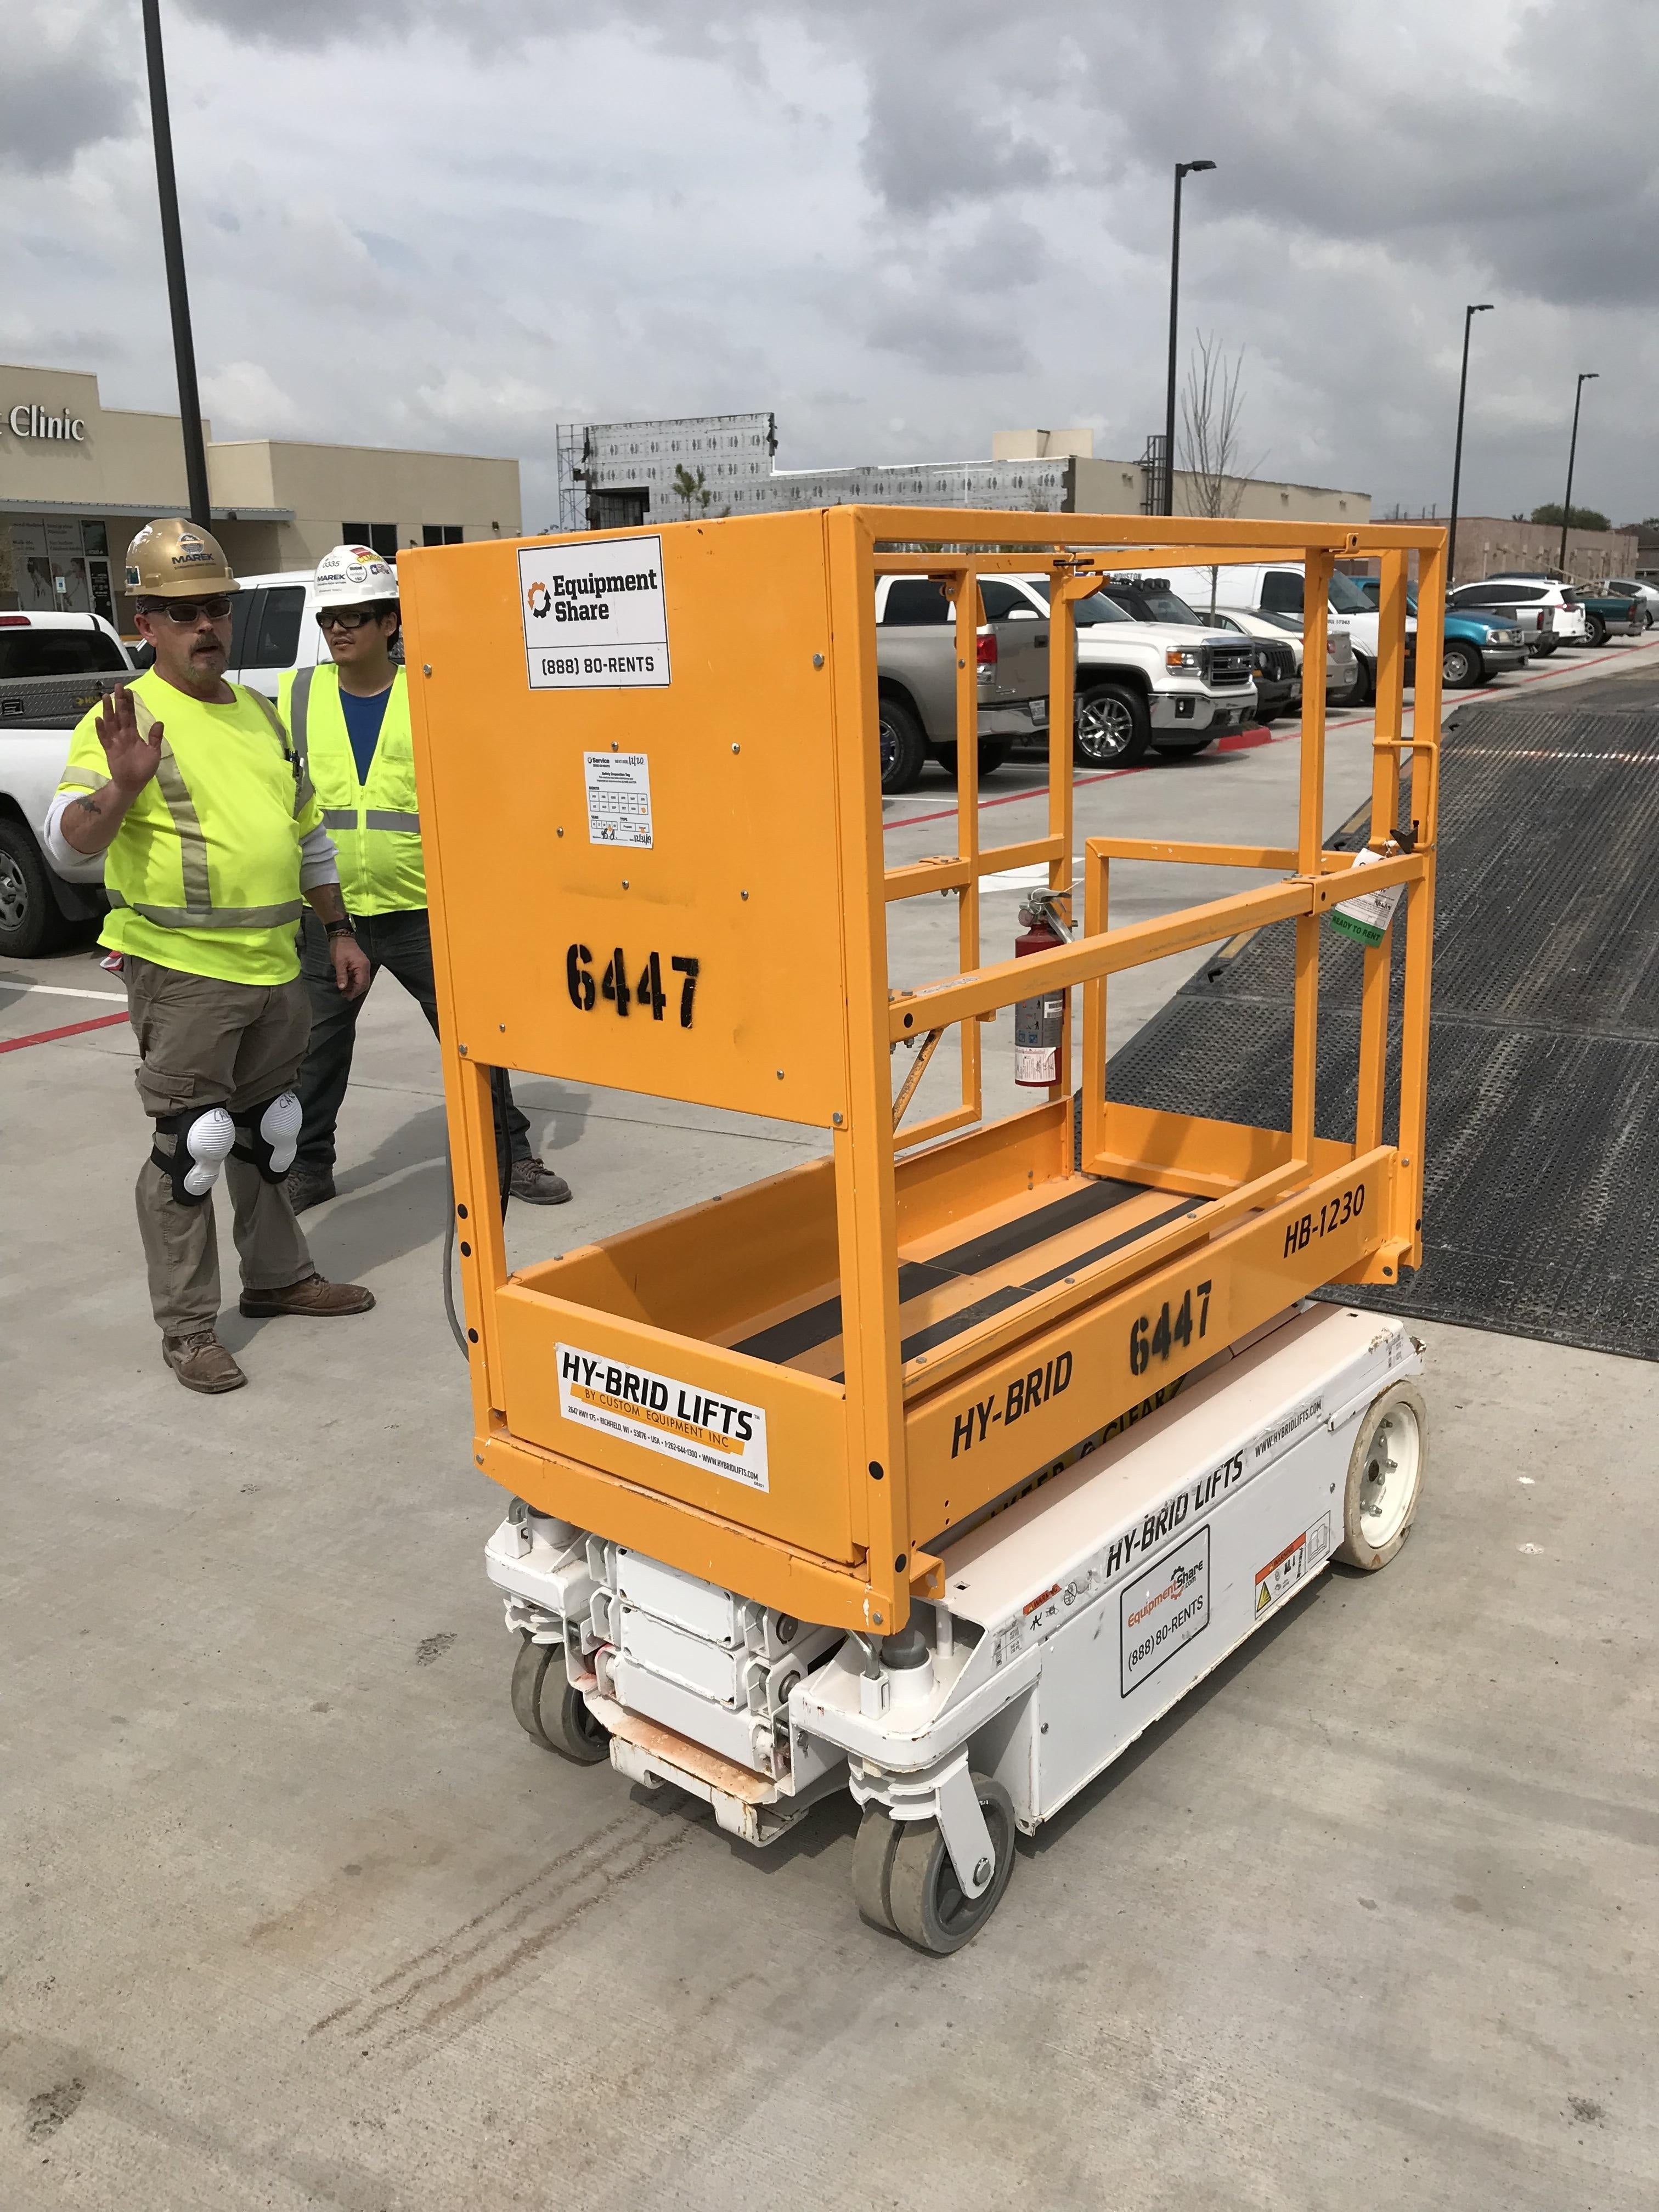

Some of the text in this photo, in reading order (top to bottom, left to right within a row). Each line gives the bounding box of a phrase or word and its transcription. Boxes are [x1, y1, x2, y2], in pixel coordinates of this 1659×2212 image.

[10, 404, 84, 441] Clinic
[171, 553, 215, 564] MAREK
[317, 574, 346, 582] MAREK
[552, 569, 658, 600] Equipment
[555, 601, 610, 622] Share
[542, 656, 654, 676] (888) 80-RENTS
[1332, 915, 1381, 941] READY TO RENT
[567, 944, 699, 1030] 6447
[1284, 1184, 1365, 1259] HB-1230
[1130, 1279, 1212, 1376] 6447
[562, 1351, 668, 1412] HY-BRID
[677, 1390, 753, 1441] LIFTS
[585, 1389, 729, 1448] BY CUSTOM EQUIPMENT INC
[951, 1351, 1073, 1459] HY-BRID
[568, 1406, 578, 1414] 2647
[578, 1409, 588, 1419] HWY
[623, 1425, 630, 1434] WI
[633, 1429, 647, 1440] 53076
[651, 1435, 661, 1445] USA
[664, 1440, 698, 1459] 1-262-644-1300
[702, 1453, 759, 1481] WWW.HYBRIDLIFTS.COM
[1255, 1399, 1322, 1458] WWW.HYBRIDLIFTS.COM
[1106, 1449, 1244, 1578] HY-BRID LIFTS
[1033, 1586, 1058, 1607] WARNG
[1128, 1594, 1203, 1672] (888) 80-RENTS
